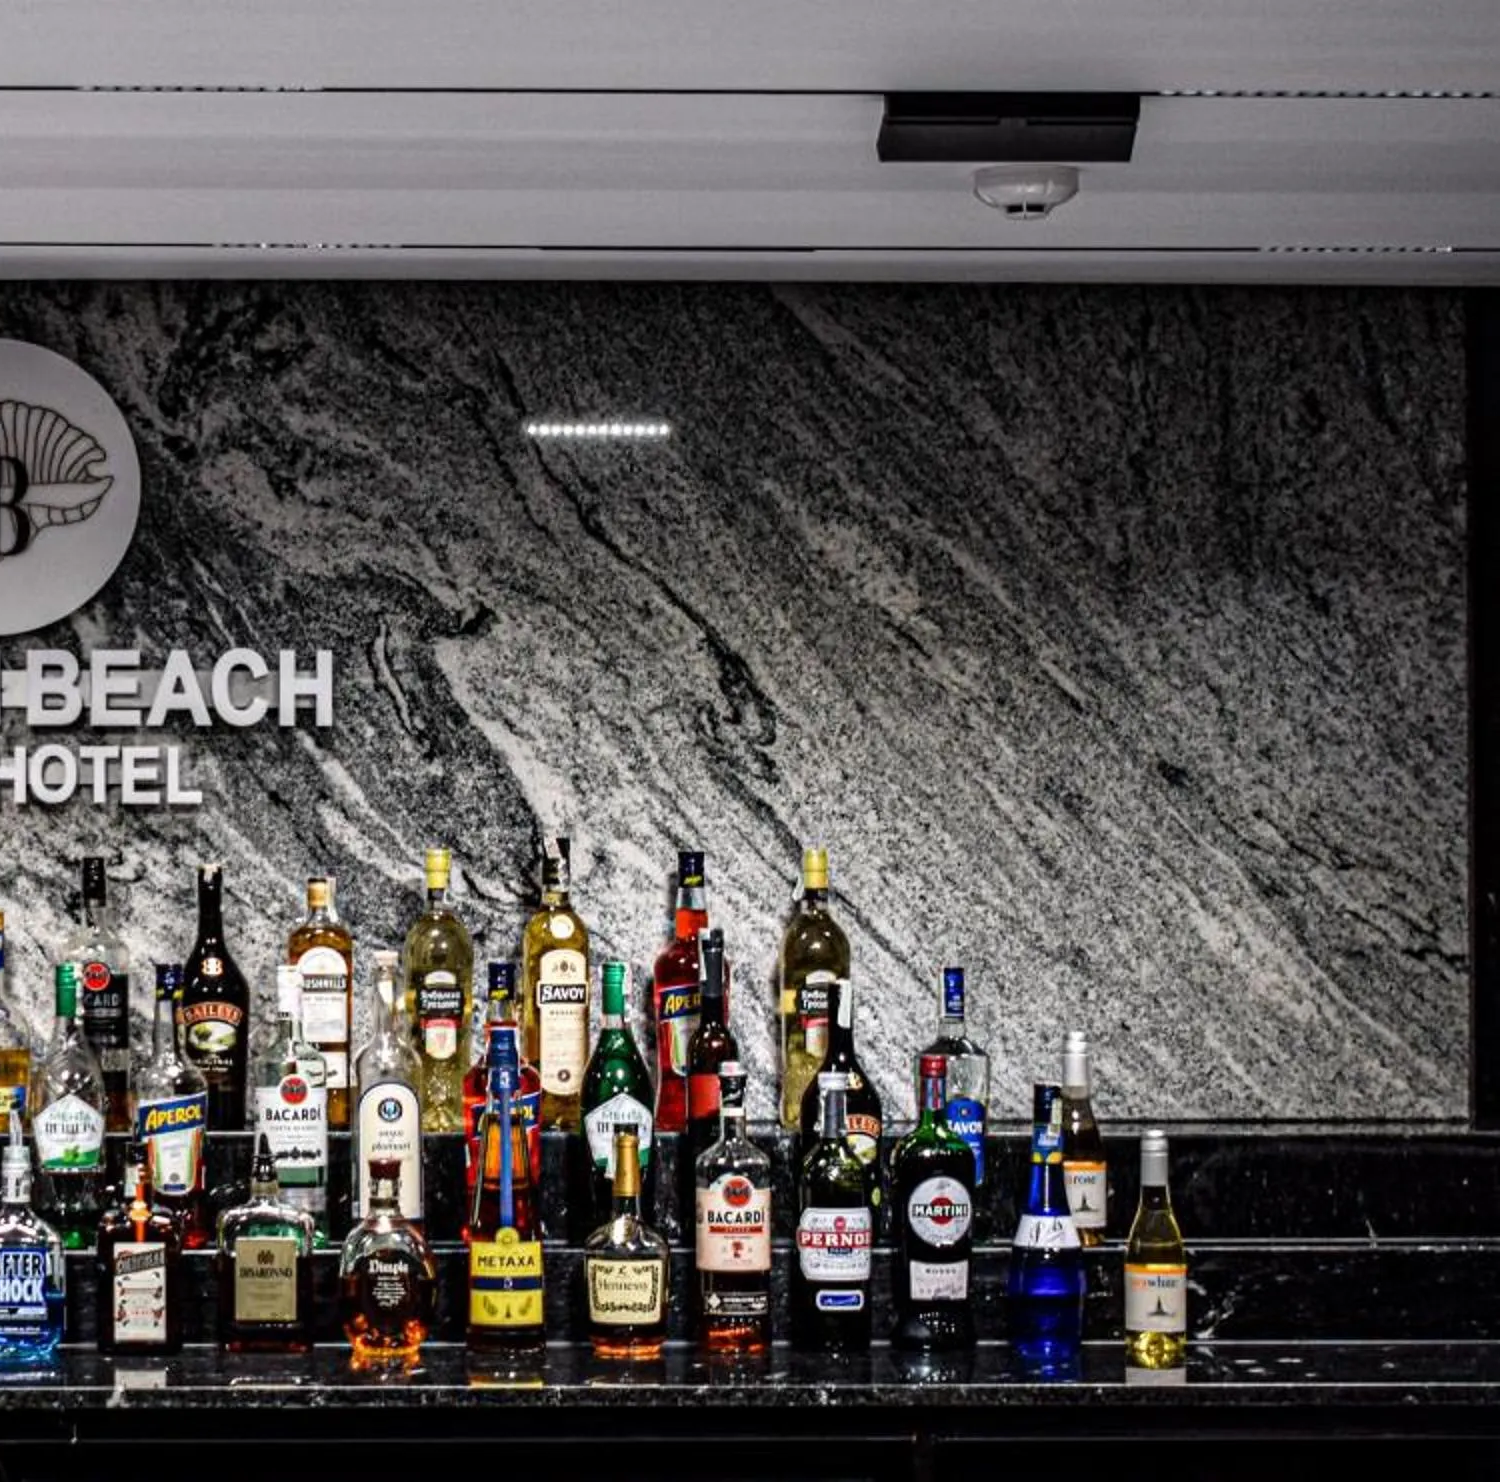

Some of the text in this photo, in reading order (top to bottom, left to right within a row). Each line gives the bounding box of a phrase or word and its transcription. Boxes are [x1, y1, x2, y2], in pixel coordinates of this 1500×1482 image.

[26, 648, 334, 728] BEACH
[542, 985, 584, 1001] SAVOY
[185, 1002, 243, 1025] BAILEYS
[146, 1104, 202, 1131] APEROL
[915, 1205, 967, 1217] MARTINI
[477, 1255, 536, 1267] METAXA
